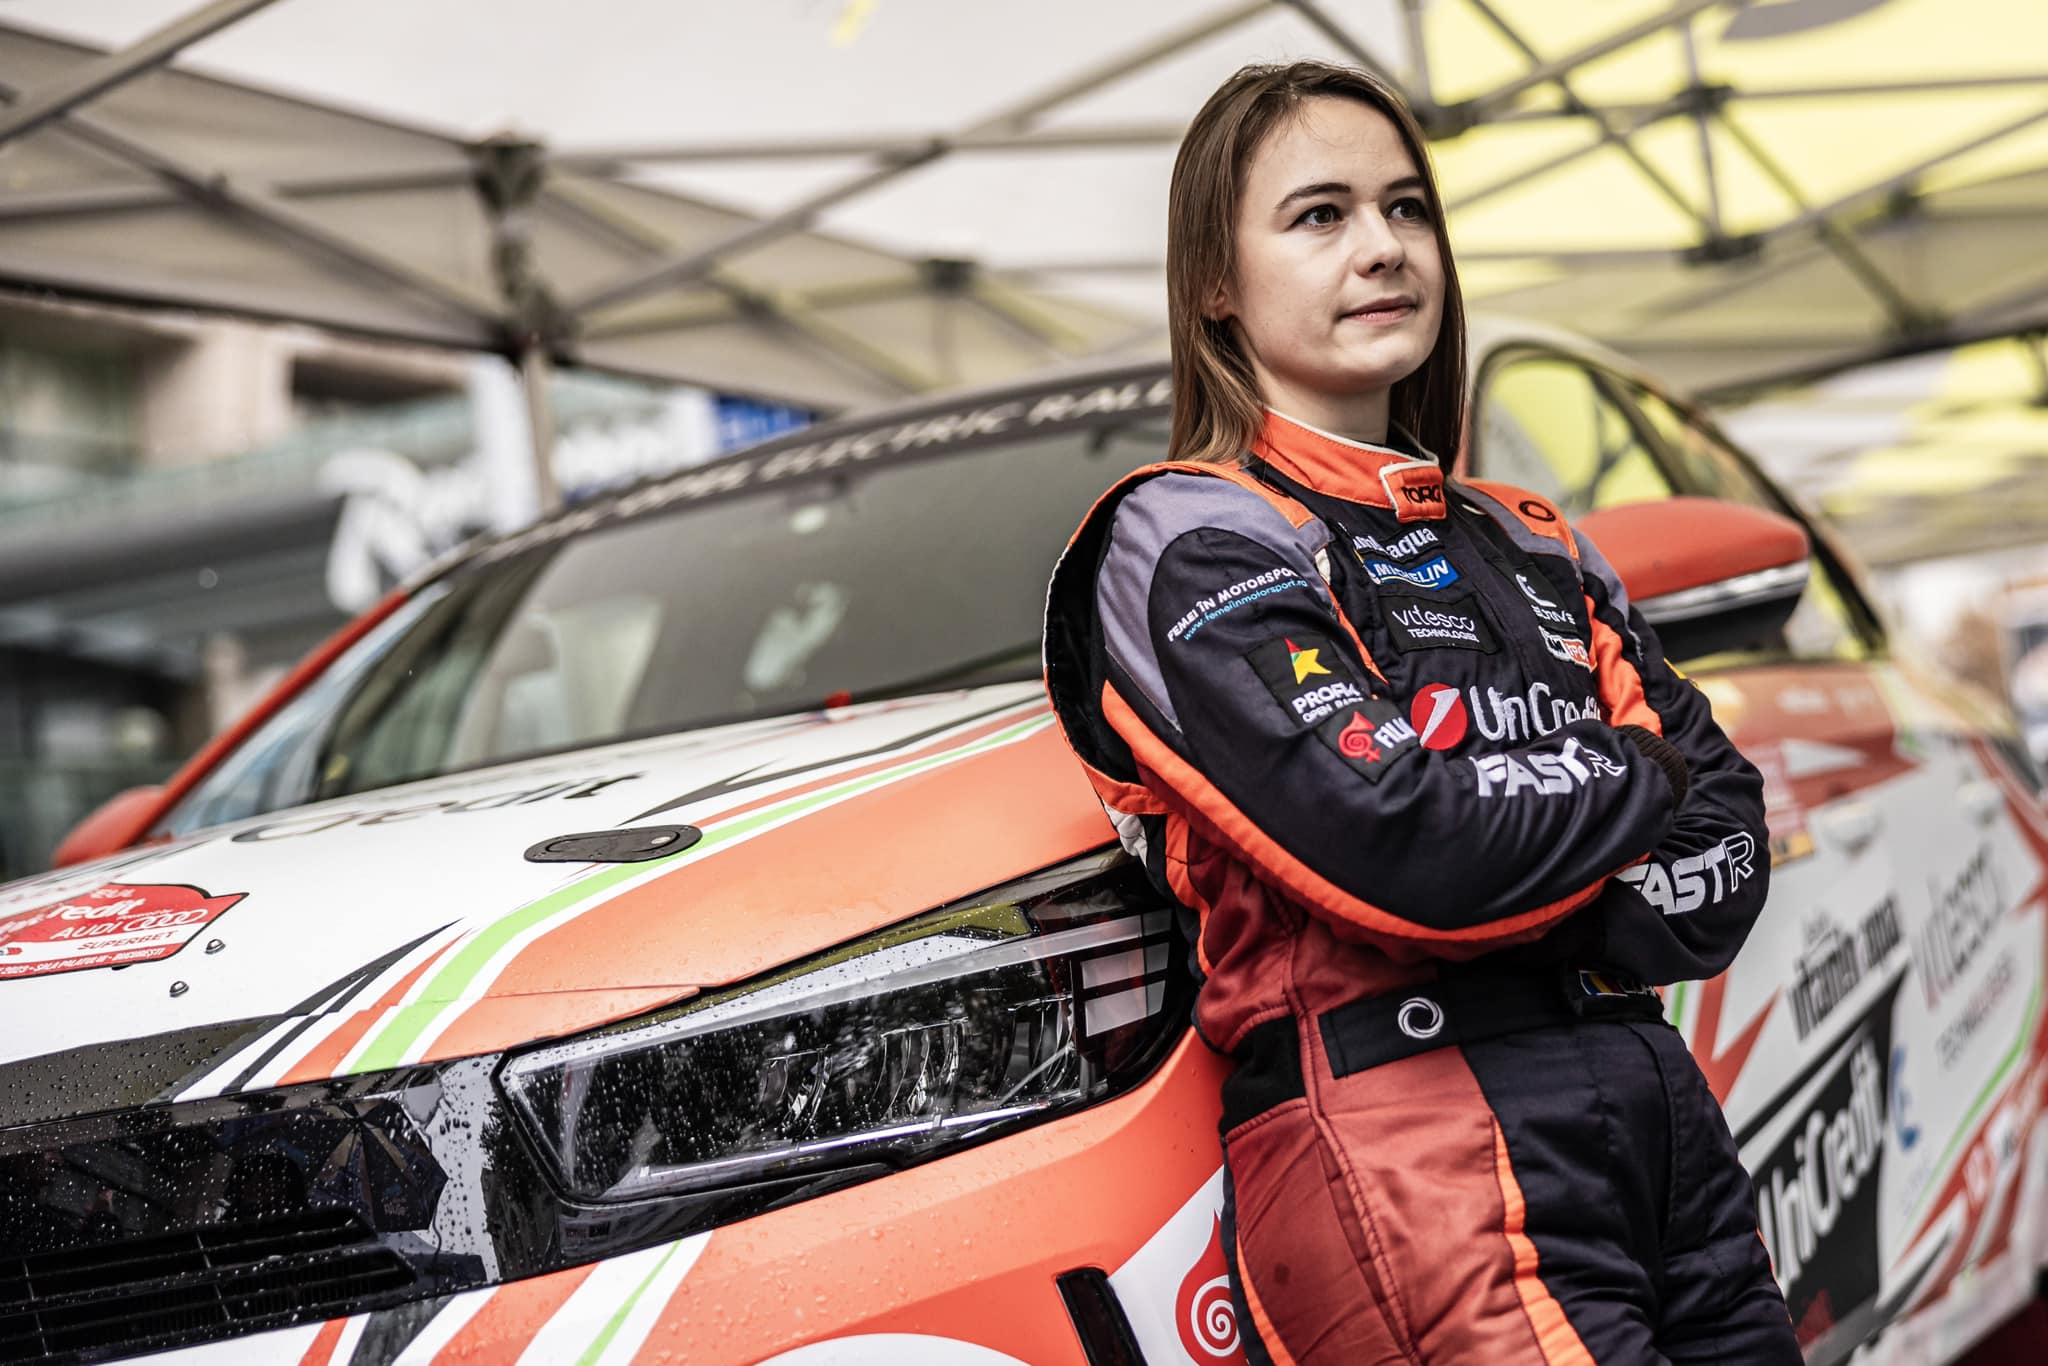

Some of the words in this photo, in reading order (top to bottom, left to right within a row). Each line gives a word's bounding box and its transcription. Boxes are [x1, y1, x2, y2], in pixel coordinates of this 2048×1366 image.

[1167, 609, 1199, 642] FEMEI
[1217, 567, 1299, 604] MOTORSPO
[49, 921, 123, 940] AUDI
[77, 929, 179, 950] SUPERBET
